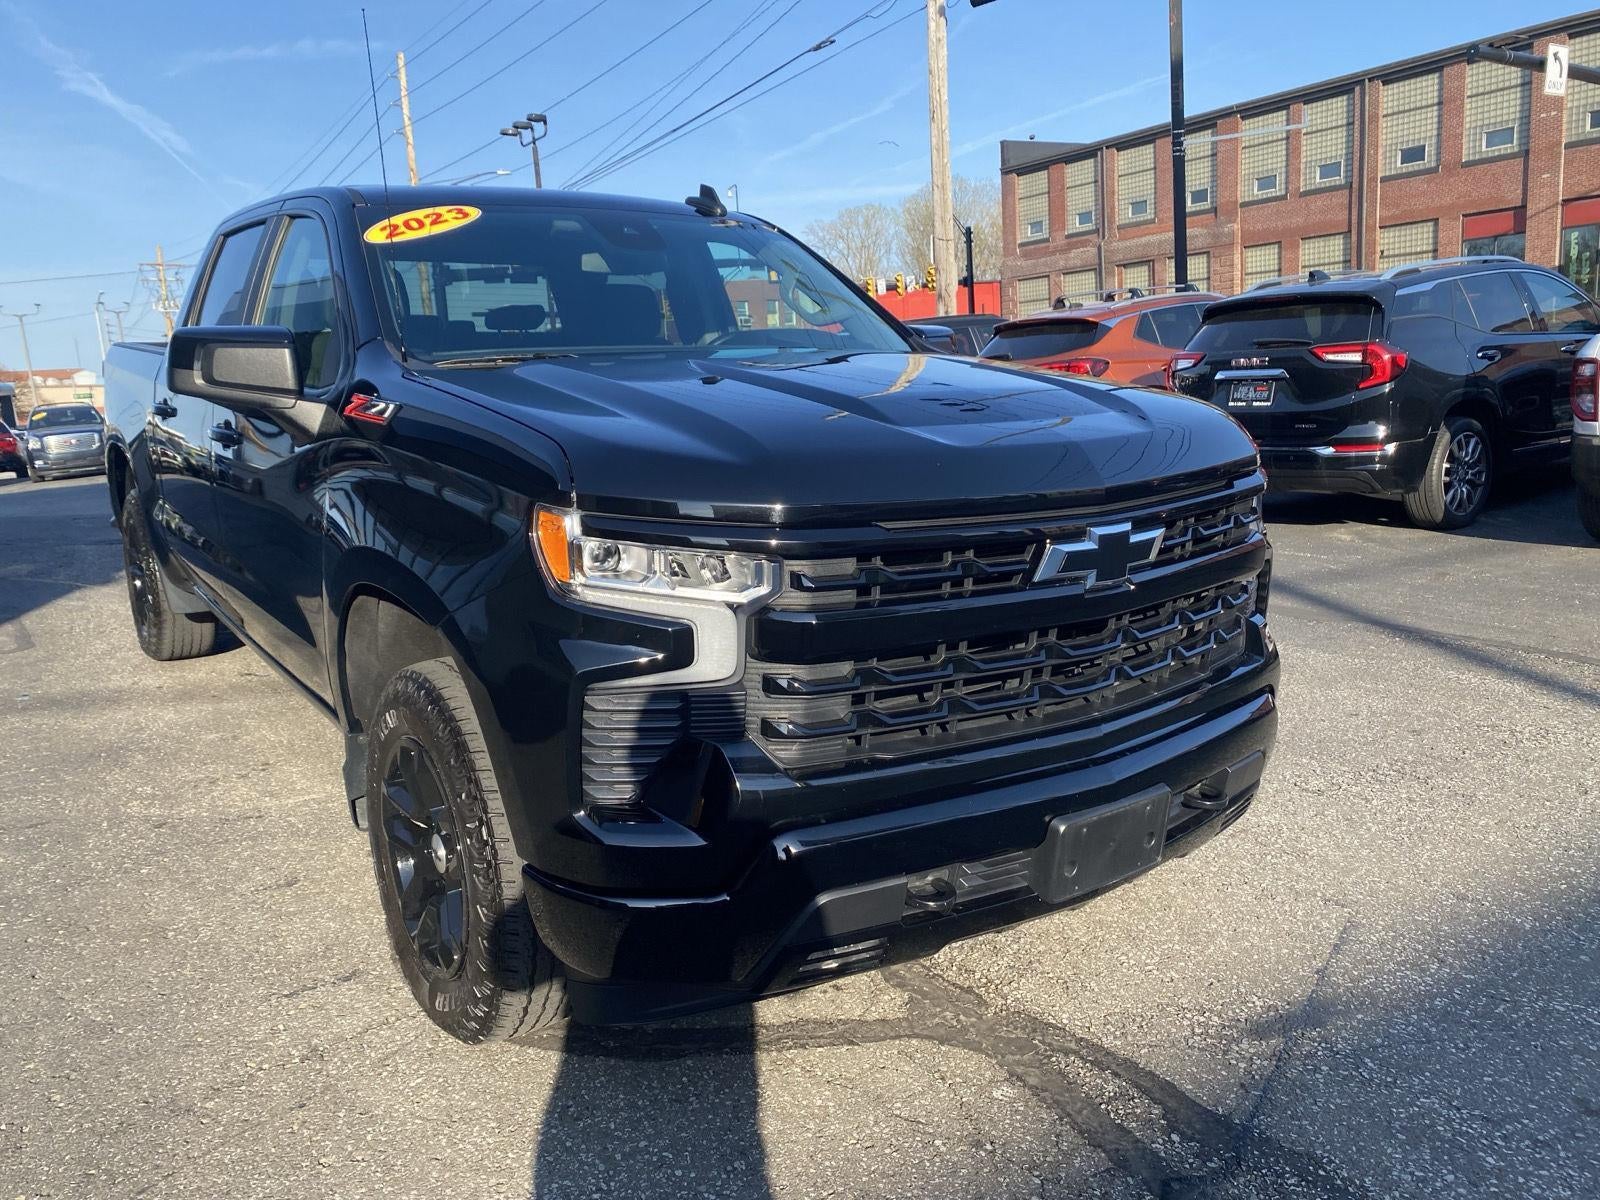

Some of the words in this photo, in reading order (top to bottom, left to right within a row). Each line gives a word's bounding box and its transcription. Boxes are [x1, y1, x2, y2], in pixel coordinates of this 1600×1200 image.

[1547, 80, 1564, 90] ONLY
[379, 207, 470, 240] 2023
[1231, 356, 1269, 366] GMC
[343, 392, 396, 425] Z71
